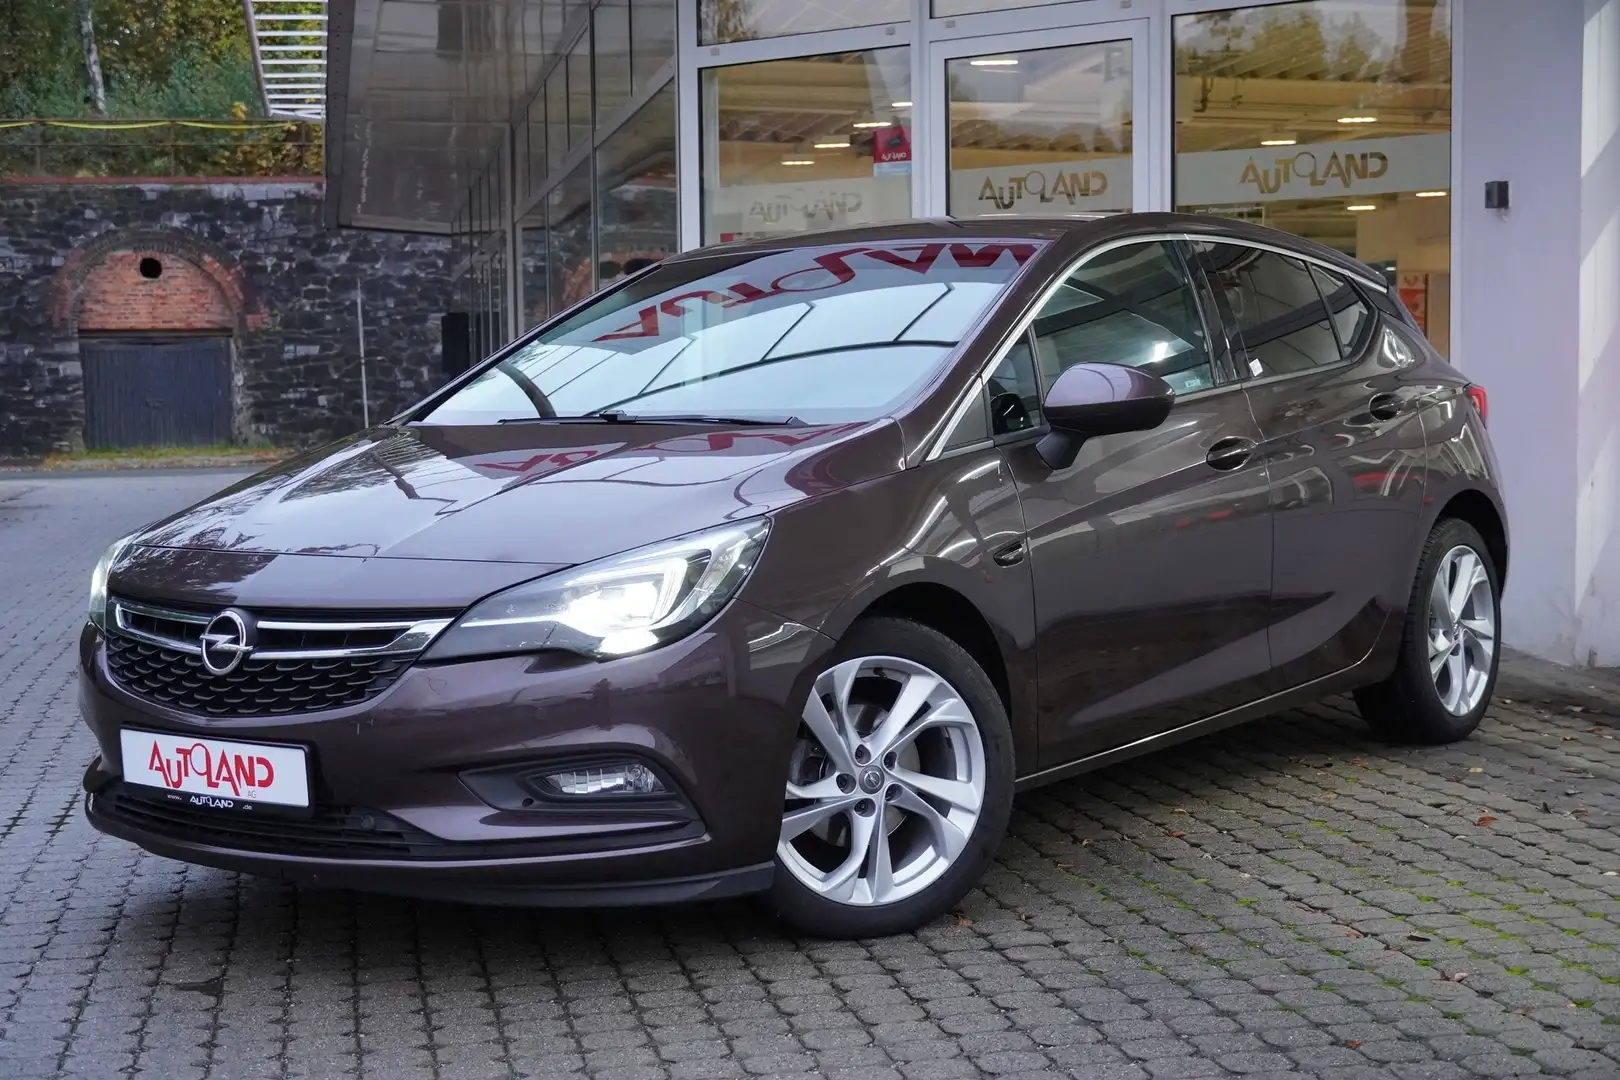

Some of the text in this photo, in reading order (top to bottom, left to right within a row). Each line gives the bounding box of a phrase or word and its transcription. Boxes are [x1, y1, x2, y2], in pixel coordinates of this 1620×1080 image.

[978, 170, 1108, 210] AUTOLAND
[1239, 150, 1388, 194] AUTOLAND
[149, 740, 275, 796] AUTOLAND
[190, 795, 234, 809] AUTOLAND
